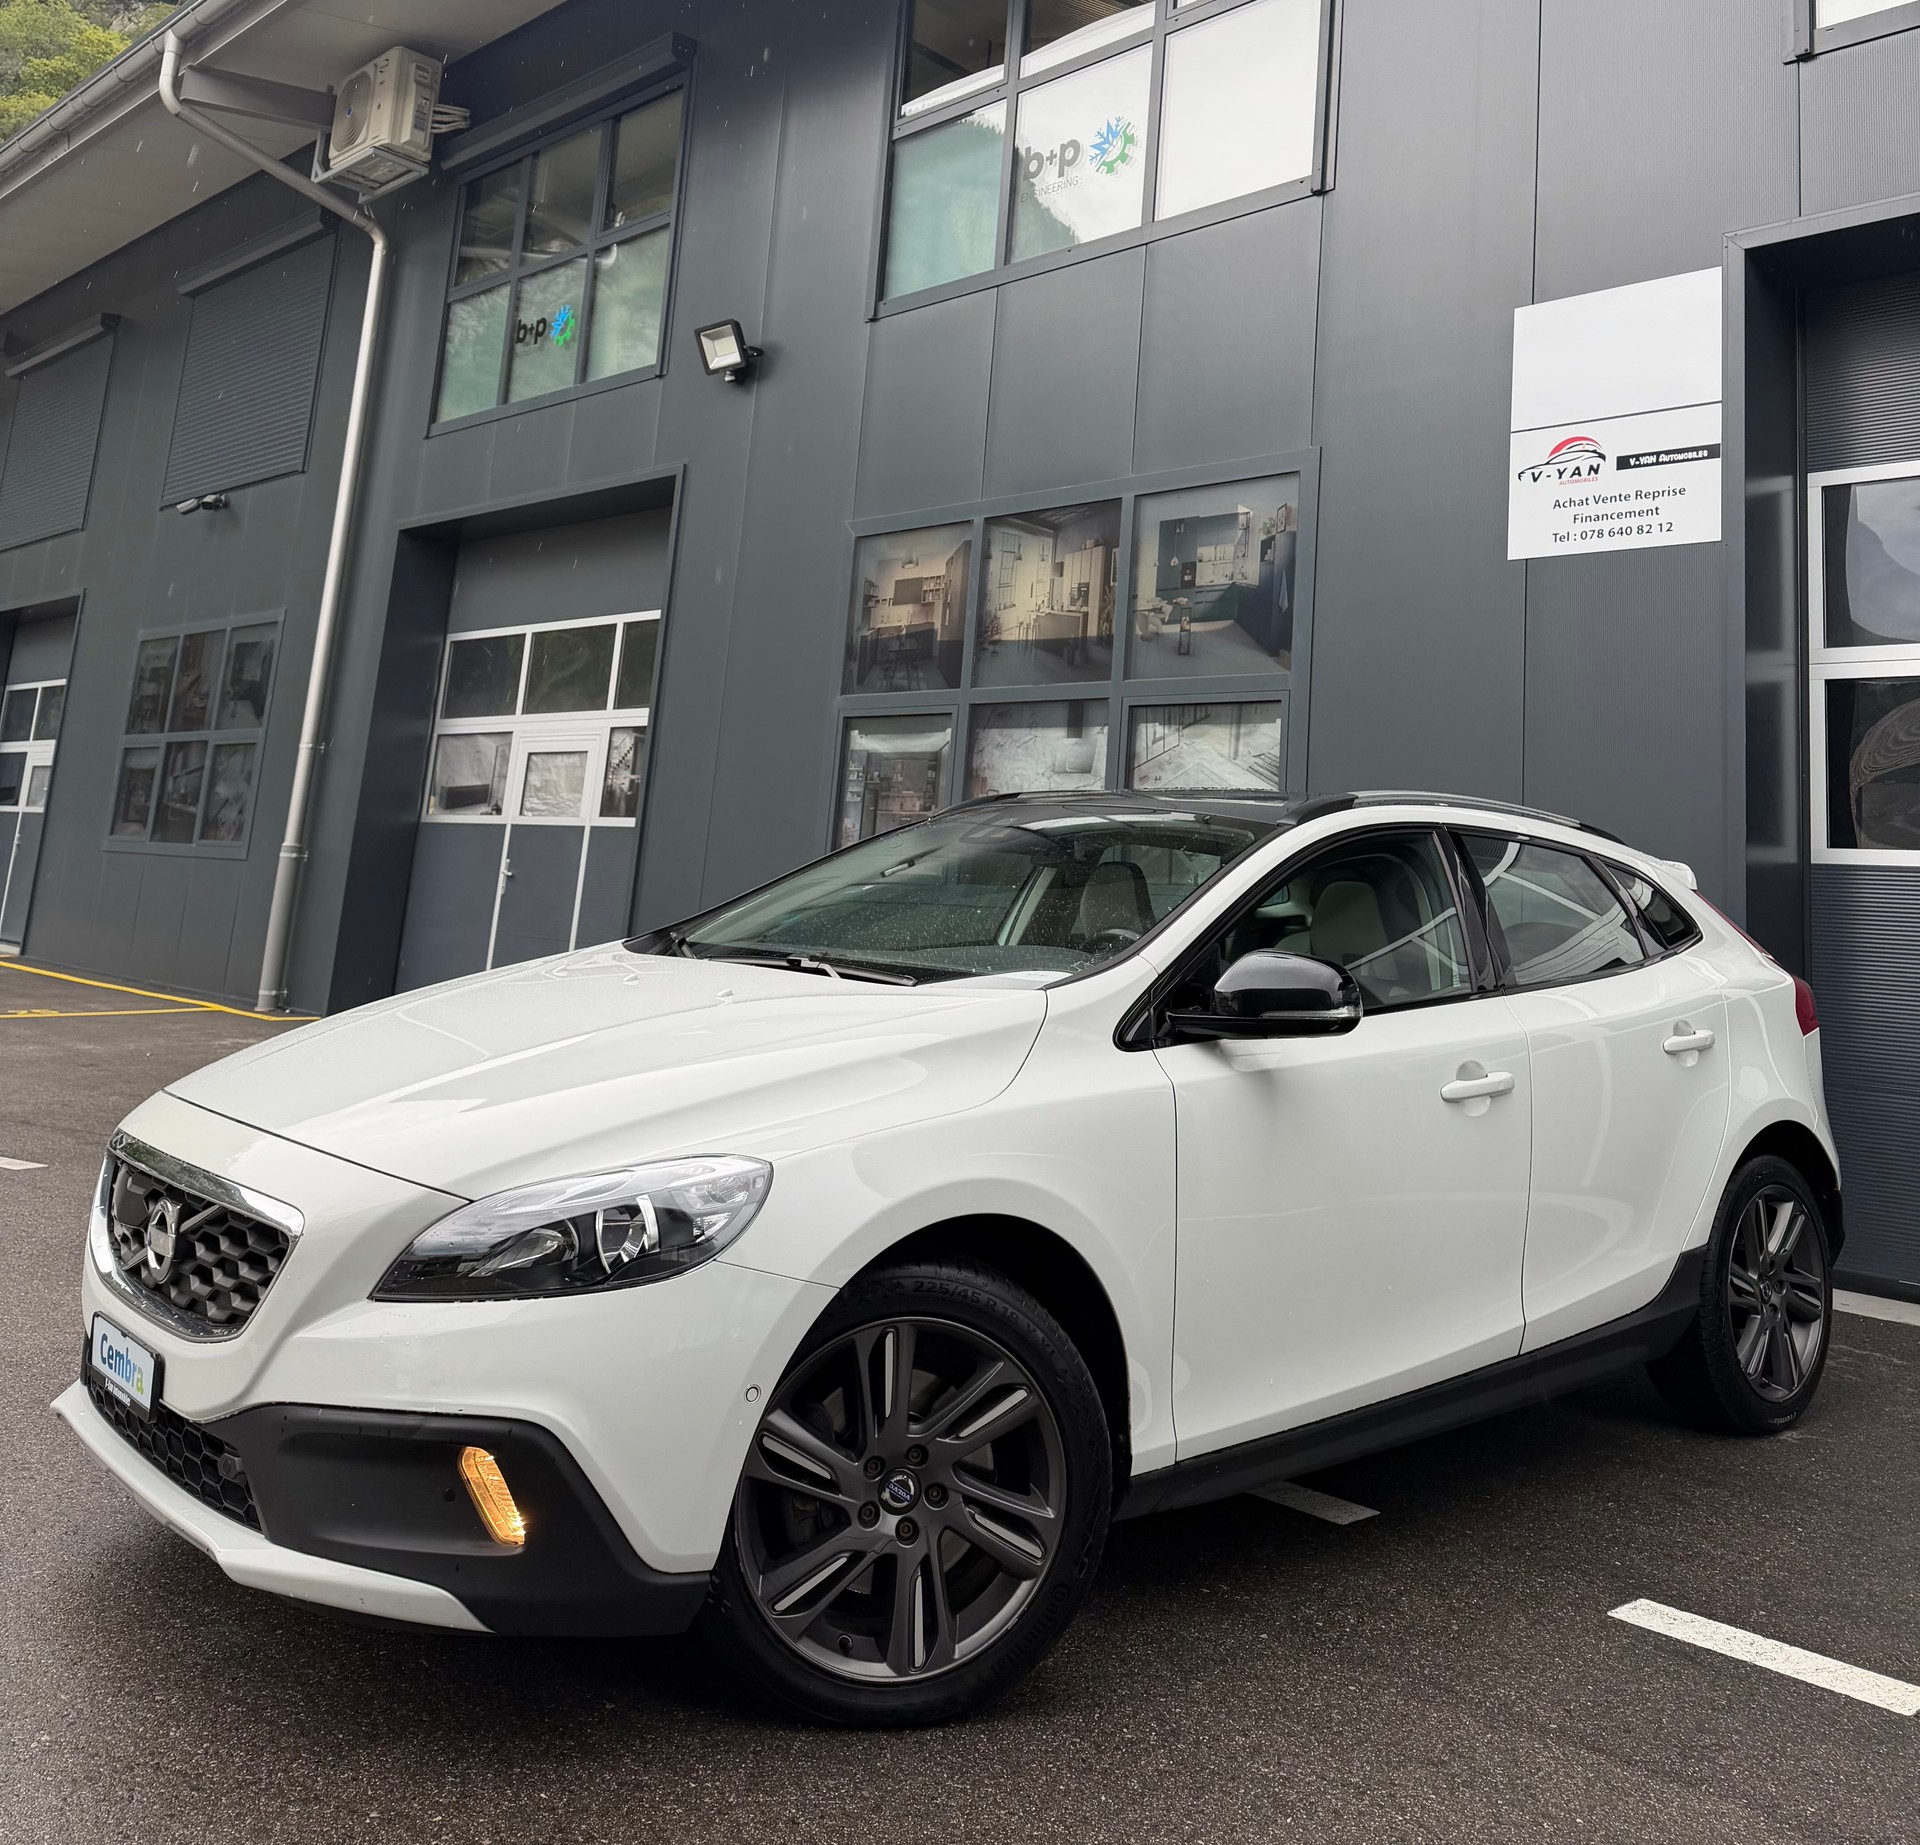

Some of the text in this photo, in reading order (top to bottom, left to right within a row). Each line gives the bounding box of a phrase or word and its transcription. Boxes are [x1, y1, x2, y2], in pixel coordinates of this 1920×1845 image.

[1022, 139, 1081, 181] b+p
[515, 317, 547, 345] b+p
[1629, 454, 1657, 466] V-YAN
[1530, 463, 1601, 483] V-YAN
[1558, 476, 1599, 486] AUTOMOBILES
[1552, 485, 1687, 510] Achat Vente Reprise
[1573, 506, 1660, 524] Financement
[1580, 528, 1605, 540] 078
[1607, 525, 1633, 538] 640
[1636, 523, 1653, 535] 82
[1657, 521, 1675, 533] 12
[914, 1280, 981, 1303] 225/45
[100, 1332, 145, 1395] Cembra
[888, 1483, 911, 1501] VOLVO
